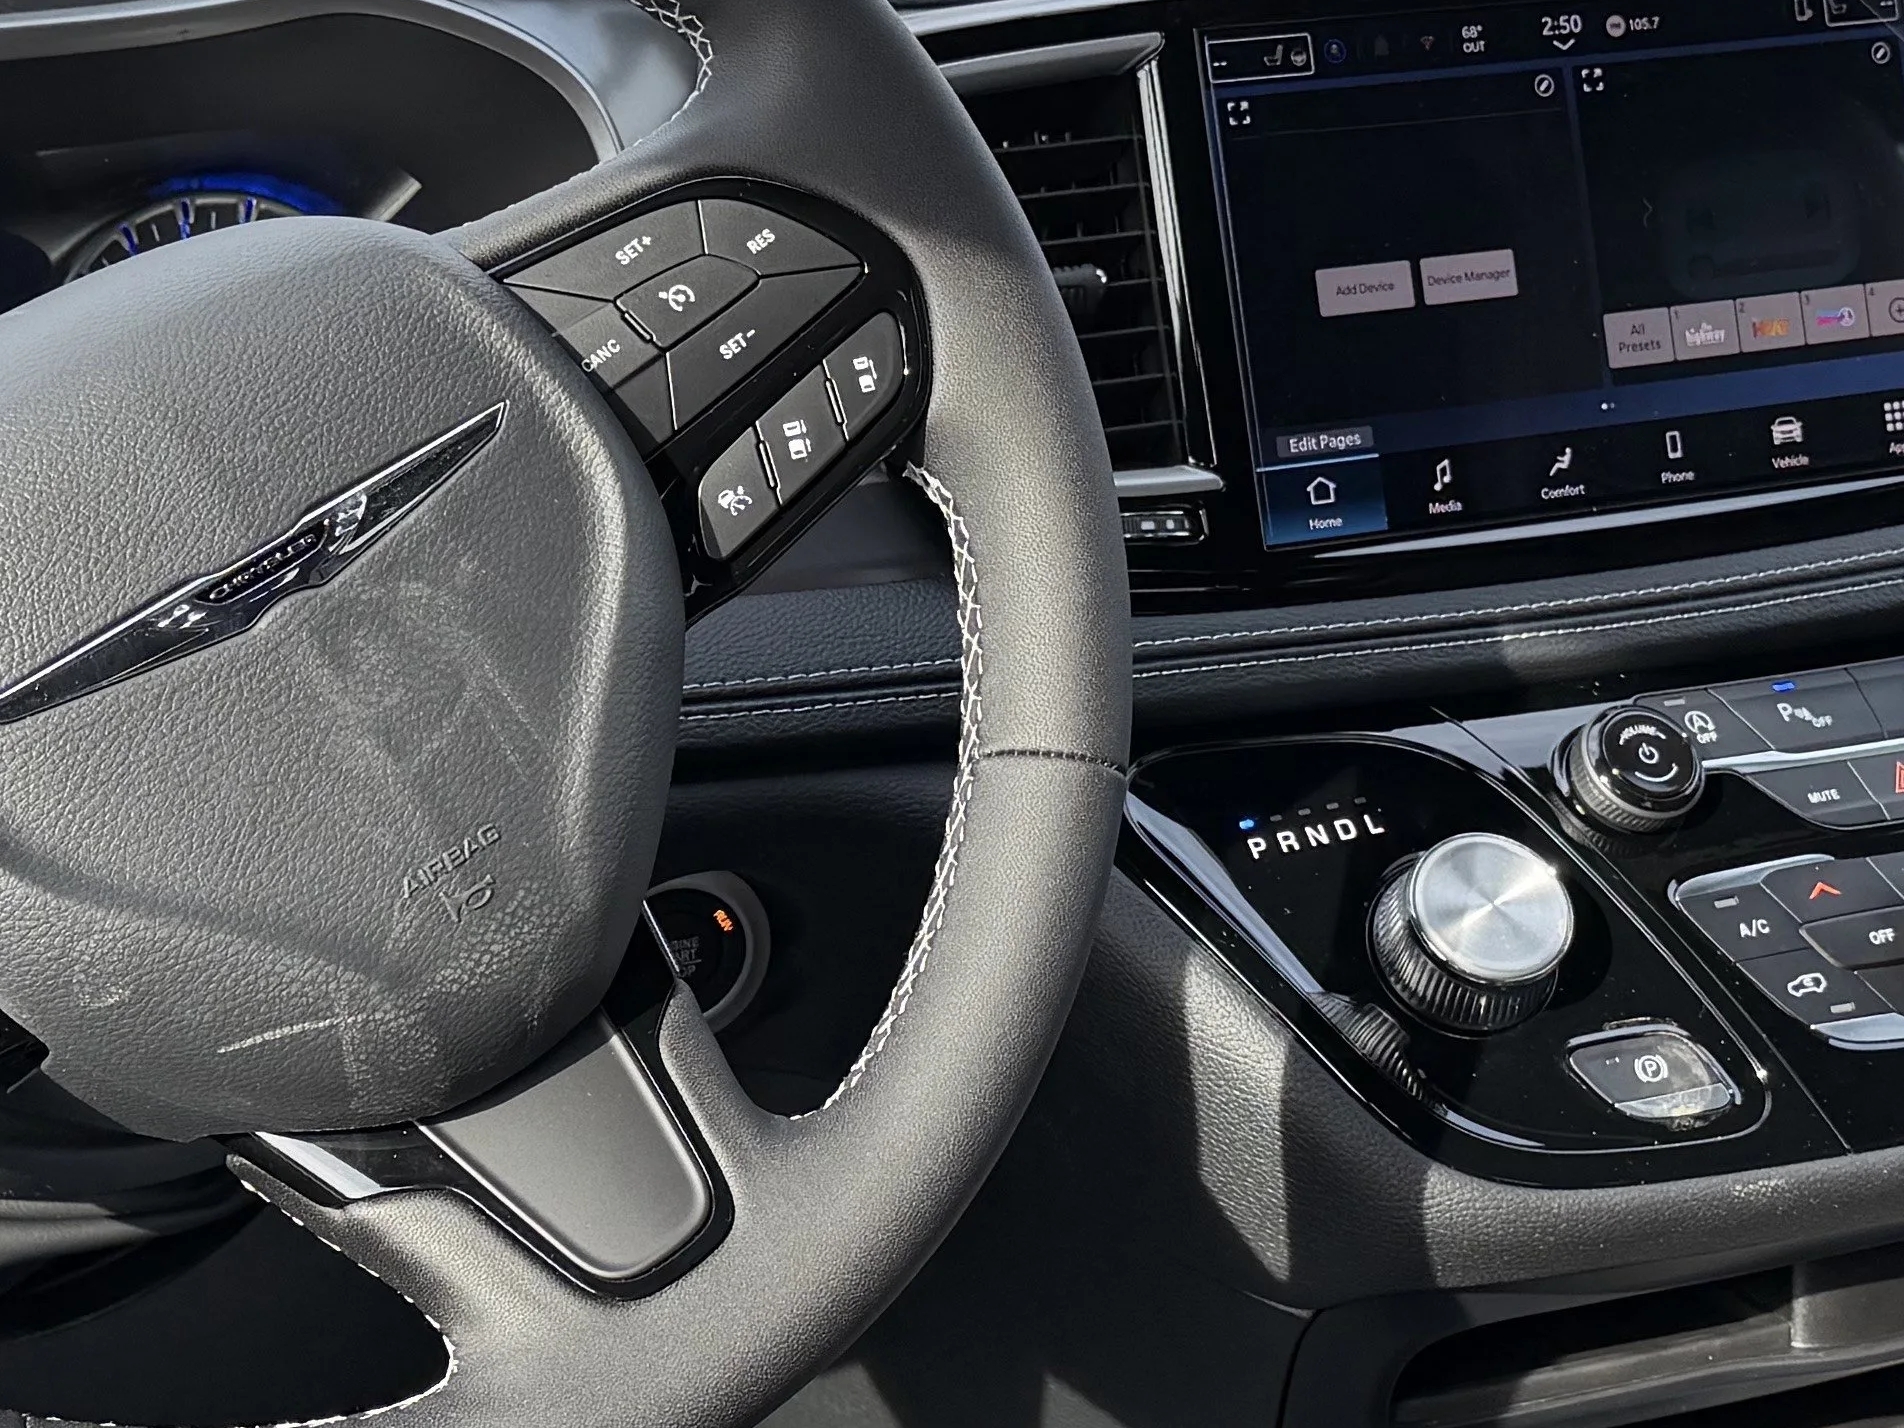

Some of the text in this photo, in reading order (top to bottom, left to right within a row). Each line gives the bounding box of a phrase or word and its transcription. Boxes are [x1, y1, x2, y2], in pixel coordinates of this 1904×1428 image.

[1542, 15, 1583, 36] 2:50
[1629, 16, 1660, 31] 105.7
[1463, 42, 1485, 53] OUT
[746, 228, 776, 255] RES
[1427, 269, 1510, 287] Device Manager
[1336, 282, 1395, 296] Add Device
[1630, 323, 1645, 336] All
[1618, 340, 1661, 353] Presets
[581, 338, 621, 372] CANC
[1289, 433, 1361, 453] Edit Pages
[1772, 454, 1809, 470] Vehicle
[1661, 470, 1695, 485] Phone
[1541, 483, 1585, 500] Comfort
[1428, 500, 1463, 515] Media
[1309, 516, 1343, 530] Home
[1812, 714, 1833, 728] OFF
[1696, 731, 1718, 744] OFF
[1807, 788, 1840, 803] MUTE
[401, 823, 501, 899] AIRBAG
[1739, 918, 1770, 938] A/C
[1868, 928, 1895, 945] OFF
